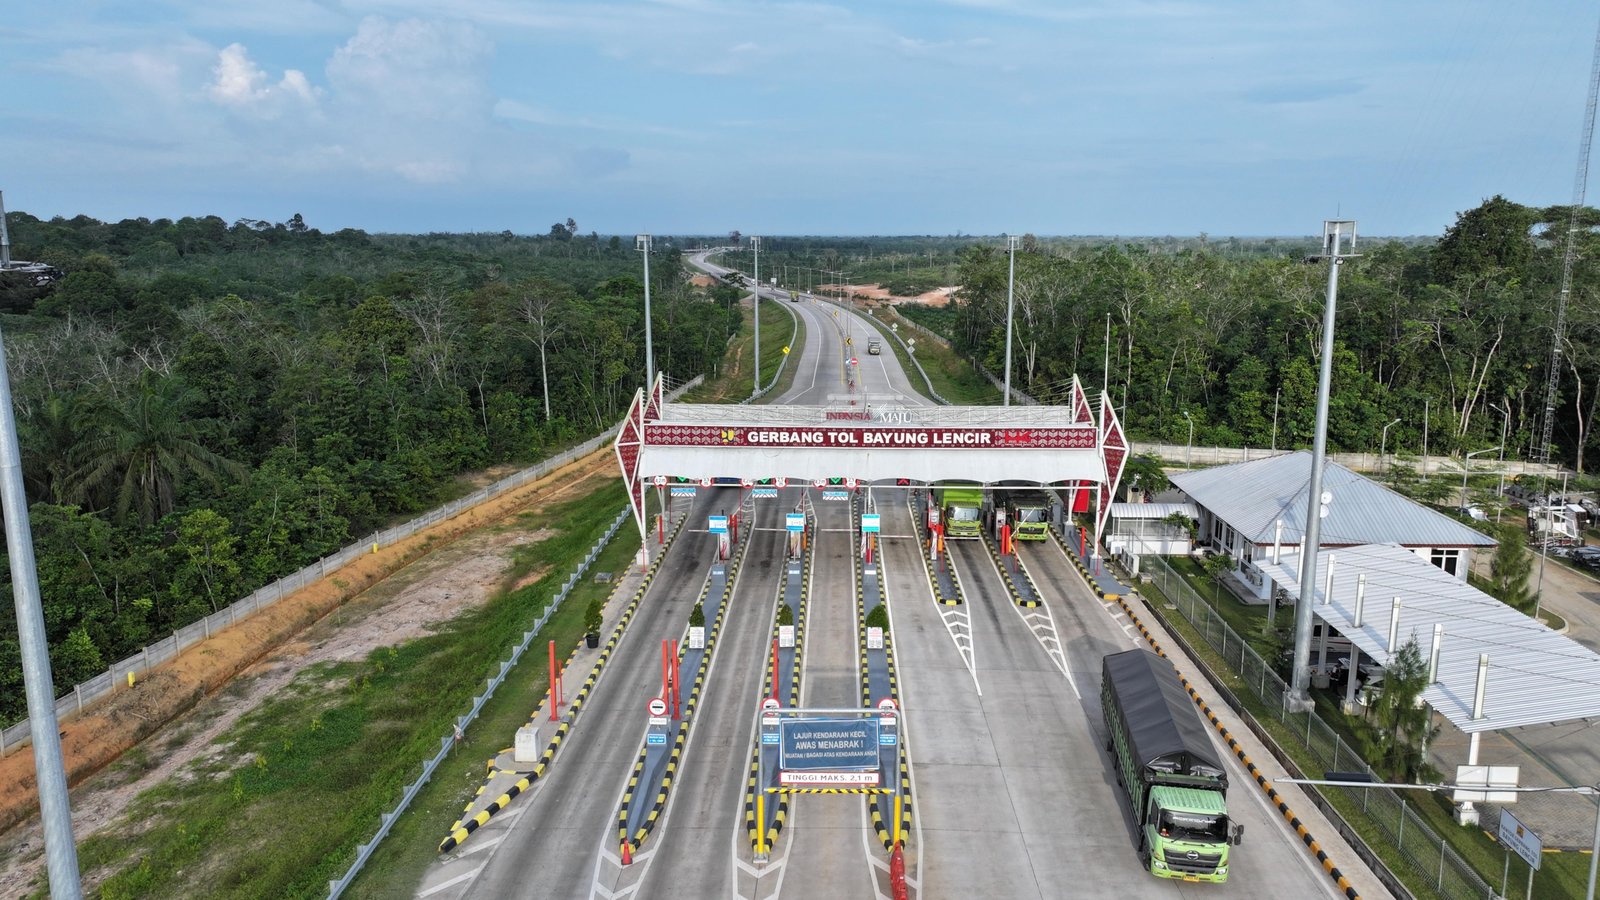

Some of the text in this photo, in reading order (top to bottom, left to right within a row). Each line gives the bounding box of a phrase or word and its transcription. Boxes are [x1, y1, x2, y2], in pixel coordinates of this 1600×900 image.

[880, 409, 912, 425] MAJU
[747, 431, 991, 445] GERBANG TOL BAYUNG LENCIR
[793, 732, 812, 740] LAJUR
[813, 731, 849, 739] KENDARAAN
[795, 741, 817, 750] AWAS
[818, 740, 859, 749] MENABRAK
[850, 774, 861, 782] 2,1
